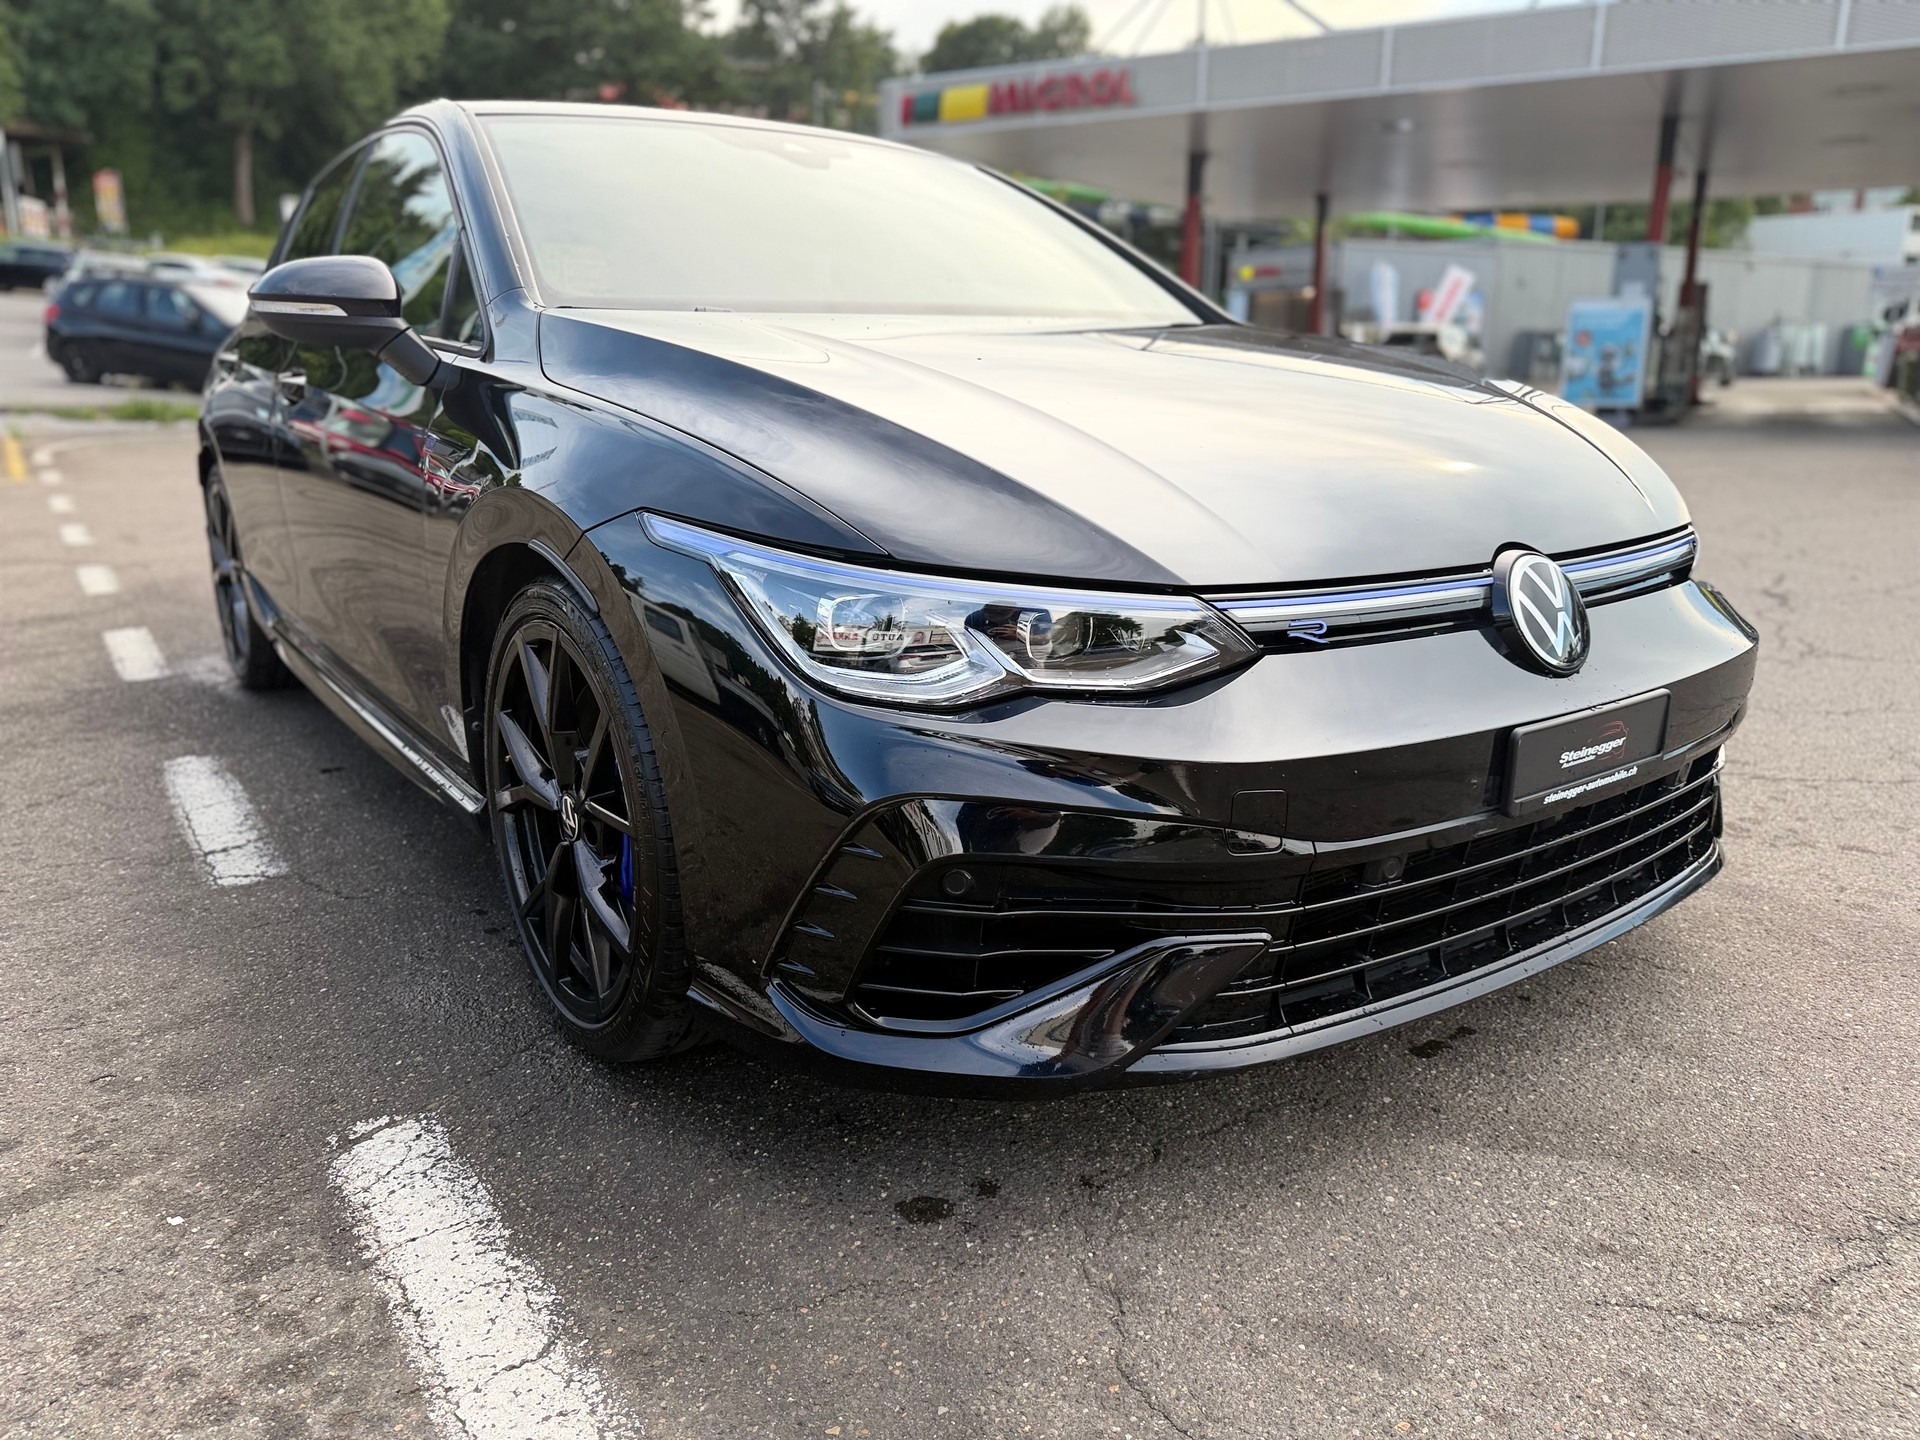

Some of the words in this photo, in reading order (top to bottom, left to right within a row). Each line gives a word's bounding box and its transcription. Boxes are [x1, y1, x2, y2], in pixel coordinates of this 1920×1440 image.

[988, 67, 1137, 117] MIGROL
[1287, 618, 1330, 644] R
[1558, 736, 1627, 764] Steinegger
[1543, 764, 1638, 805] steinegger-automobile.ch
